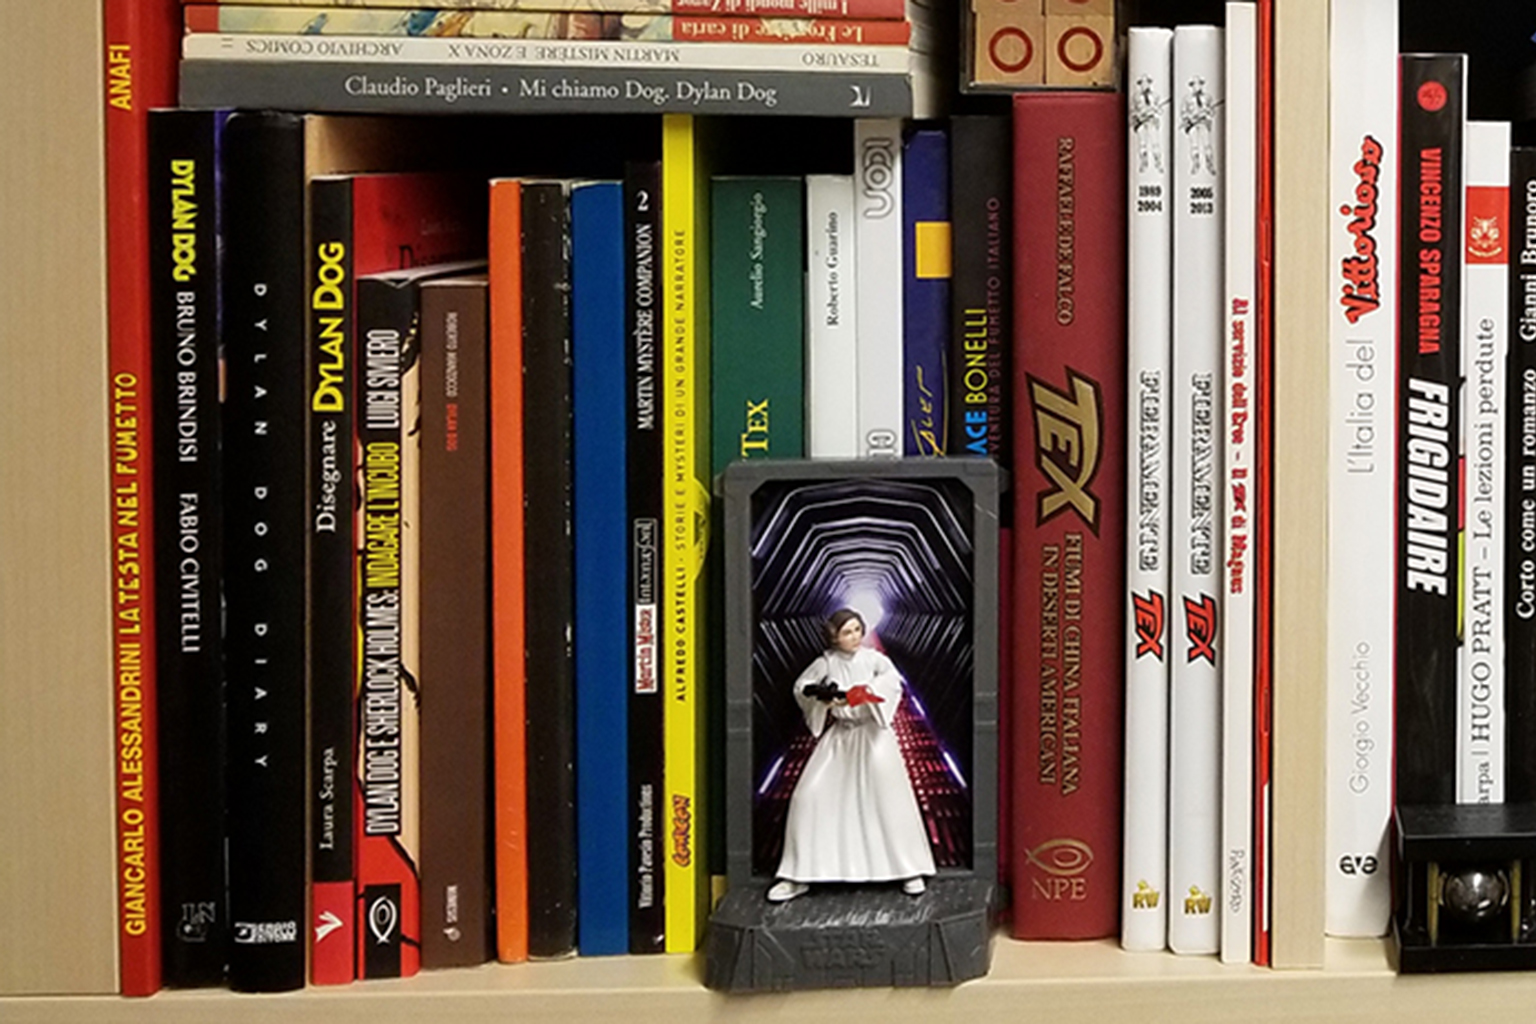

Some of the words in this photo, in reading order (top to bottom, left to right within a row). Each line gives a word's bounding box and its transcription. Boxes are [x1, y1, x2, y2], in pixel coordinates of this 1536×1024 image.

[111, 44, 131, 110] ANAFI
[344, 76, 418, 96] Claudio
[425, 77, 491, 102] Paglieri
[519, 79, 547, 97] Mi
[551, 79, 620, 98] chiamo
[624, 81, 668, 103] Dog.
[674, 82, 730, 105] Dylan
[735, 82, 776, 106] Dog
[171, 160, 196, 230] DYLAN
[637, 190, 650, 211] 2
[750, 193, 768, 260] Sangiorgio
[1418, 148, 1442, 241] VINCENZO
[171, 233, 196, 283] DOG
[635, 224, 653, 306] COMPANION
[825, 212, 840, 268] Guarino
[987, 198, 1001, 268] ITALIANO
[312, 242, 344, 310] DOG
[750, 264, 768, 309] Aurelio
[825, 272, 840, 327] Roberto
[987, 276, 1001, 344] FUMETTO
[1418, 250, 1442, 355] SPARAGNA
[176, 291, 196, 366] BRUNO
[255, 283, 267, 435] DYLAN
[312, 316, 344, 412] DYLAN
[633, 310, 654, 373] MYSTÈRE
[1477, 317, 1498, 414] perdute
[116, 373, 138, 474] FUMETTO
[177, 371, 198, 463] BRINDISI
[637, 377, 654, 430] MARTIN
[315, 421, 339, 531] Disegnare
[1024, 366, 1107, 538] TEX
[1406, 378, 1448, 596] FRIGIDAIRE
[1472, 423, 1495, 498] lezioni
[118, 482, 138, 525] NEL
[178, 492, 200, 552] FABIO
[255, 487, 267, 572] DOG
[1471, 511, 1493, 539] Le
[1516, 500, 1536, 553] come
[120, 532, 142, 602] TESTA
[1039, 546, 1060, 567] IN
[1516, 560, 1536, 617] Corto
[120, 610, 143, 633] LA
[180, 557, 201, 653] CIVITELLI
[1039, 573, 1060, 659] DESERTI
[1470, 567, 1492, 655] PRATT
[255, 624, 267, 768] DIARY
[1348, 641, 1373, 715] Vecchio
[1470, 664, 1492, 743] HUGO
[121, 643, 145, 802] ALESSANDRINI
[1039, 664, 1060, 784] AMERICANI
[1348, 720, 1373, 795] Giorgio
[320, 747, 336, 800] Scarpa
[321, 805, 334, 849] Laura
[671, 795, 692, 868] COMICON
[124, 809, 146, 935] GIANCARLO
[1032, 878, 1087, 900] NPE
